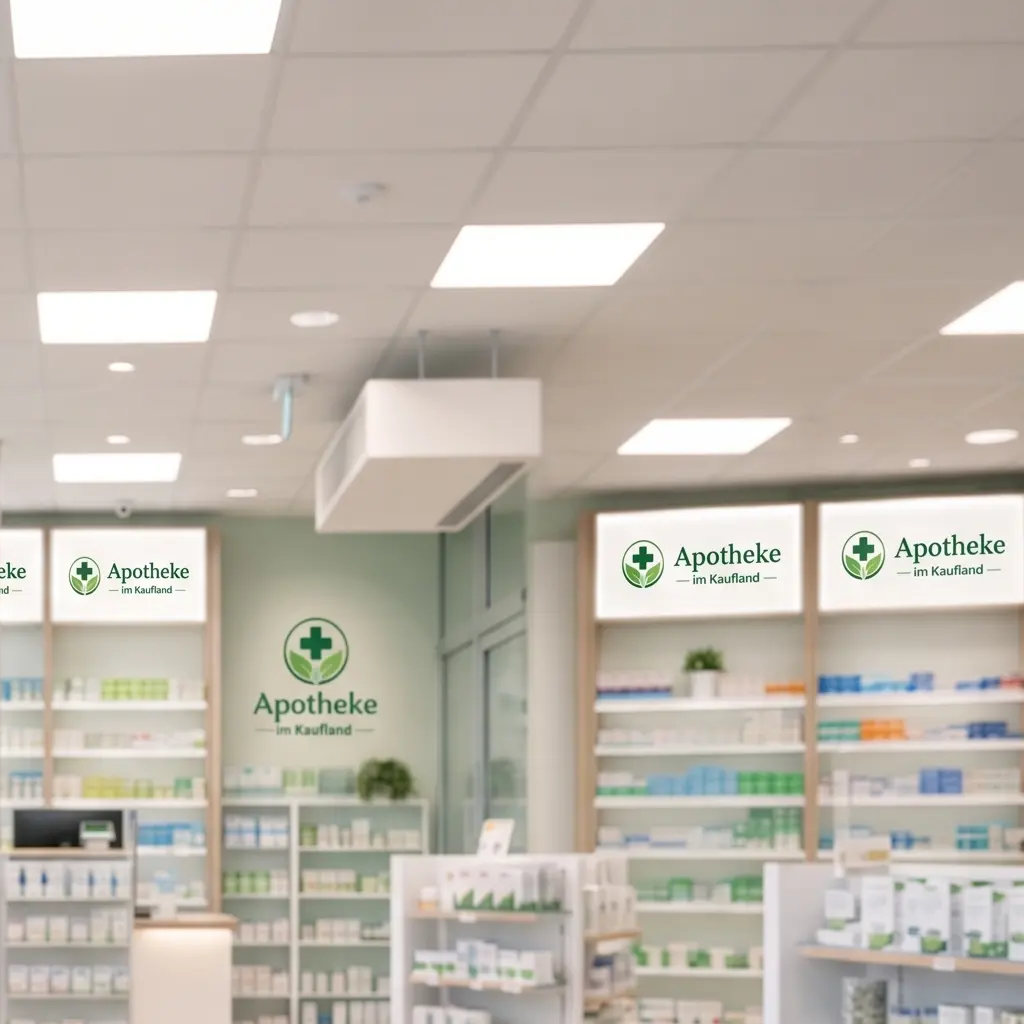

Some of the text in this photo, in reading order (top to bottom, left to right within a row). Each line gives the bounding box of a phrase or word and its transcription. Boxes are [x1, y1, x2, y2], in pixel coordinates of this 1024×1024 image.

[674, 542, 781, 572] Apotheke
[894, 534, 1006, 564] Apotheke
[107, 562, 190, 584] Apotheke
[692, 572, 760, 585] im Kaufland
[913, 564, 984, 577] im Kaufland
[121, 586, 173, 594] im Kaufland
[253, 691, 378, 723] Apotheke
[276, 724, 353, 736] im Kaufland
